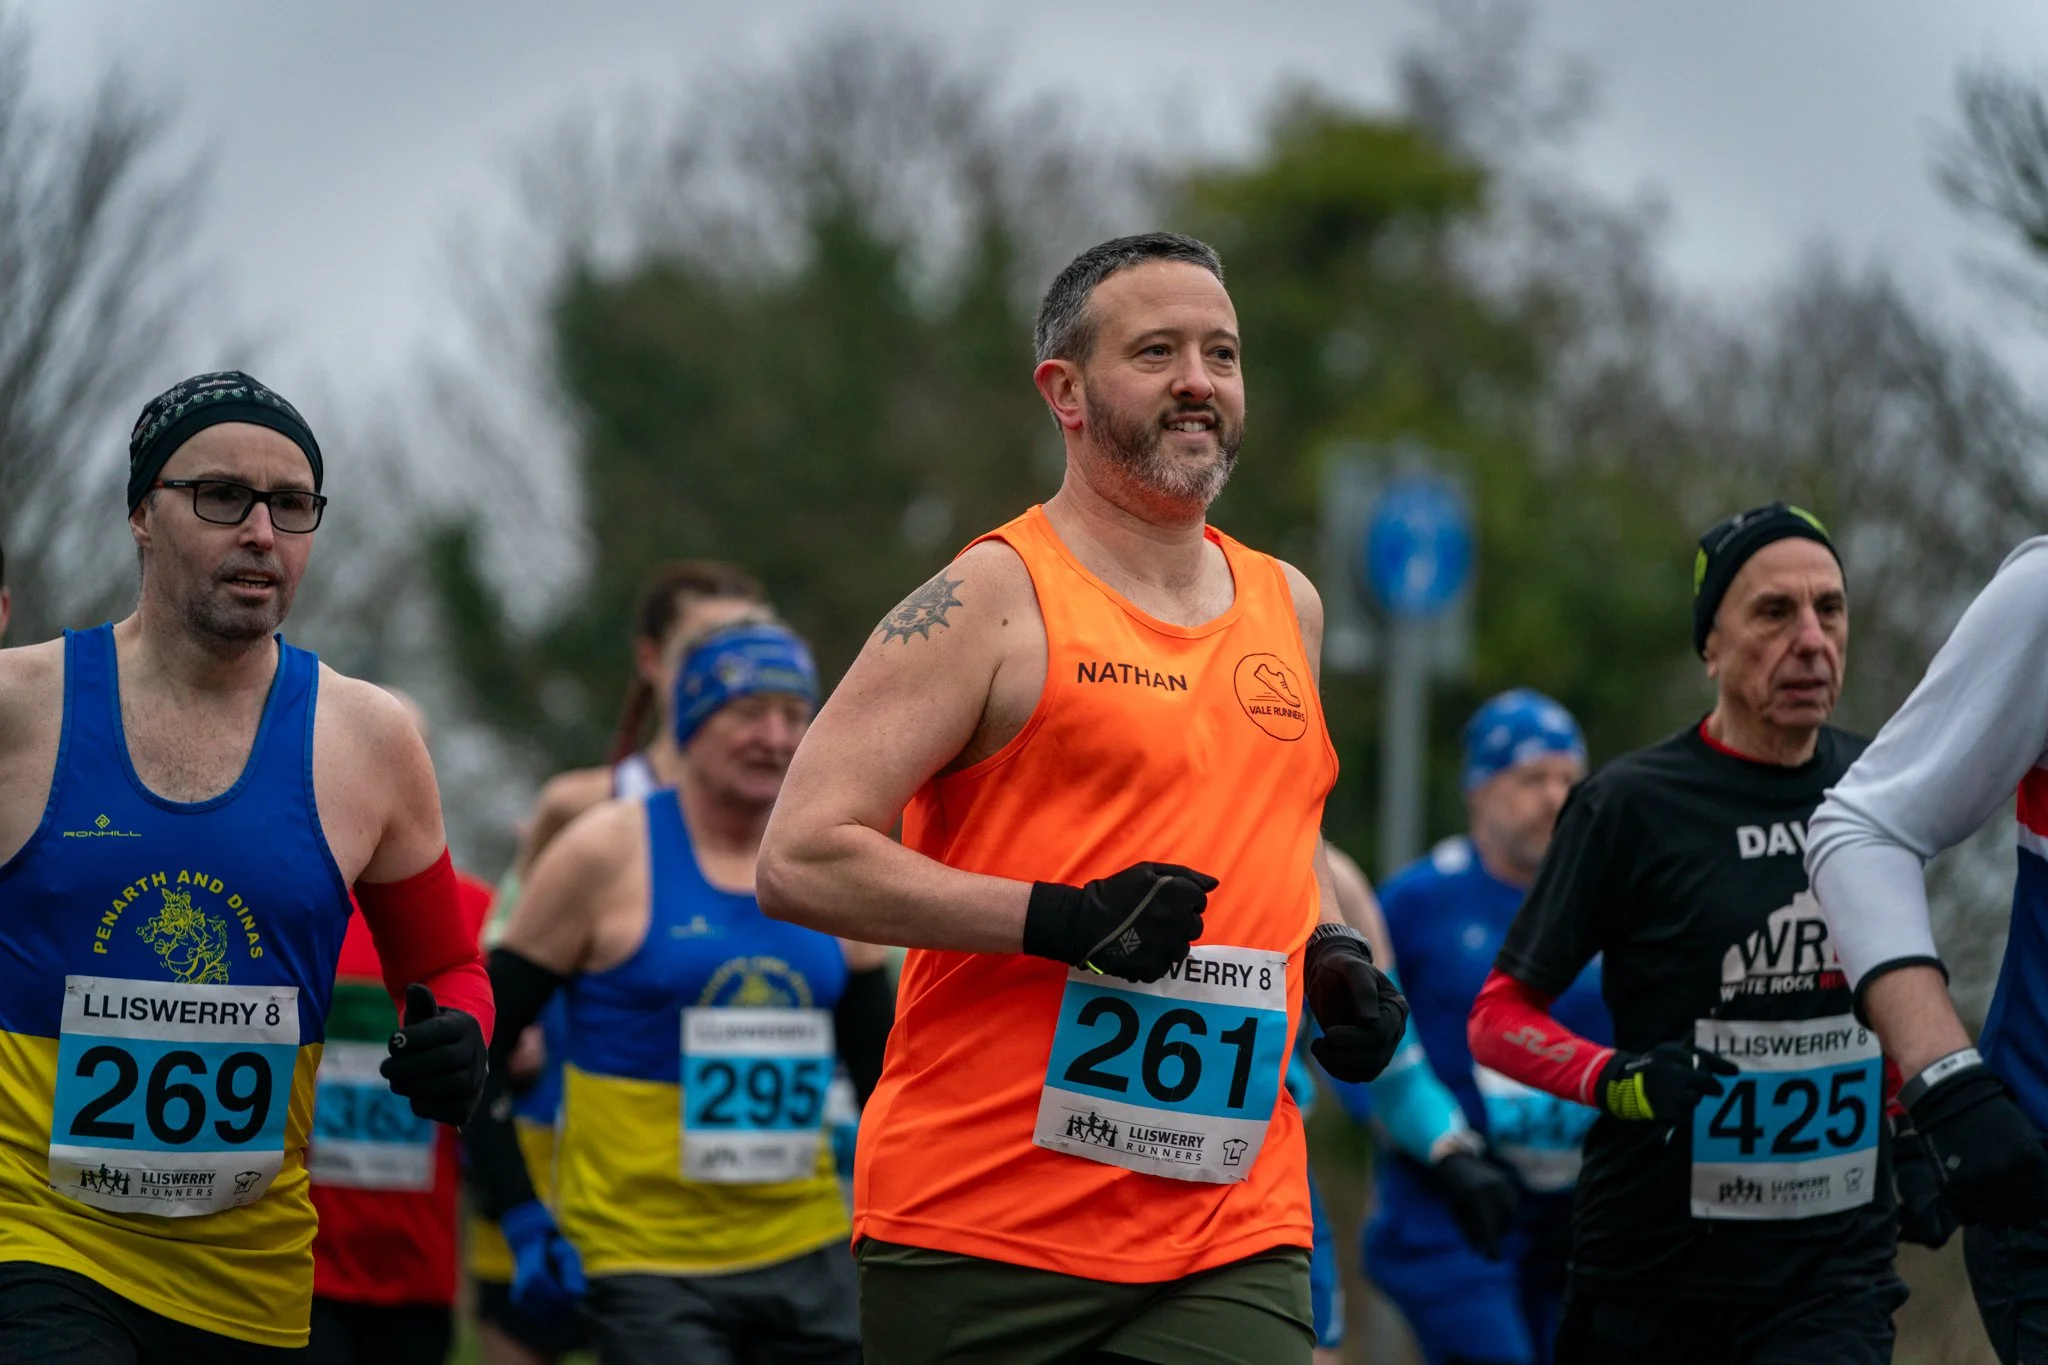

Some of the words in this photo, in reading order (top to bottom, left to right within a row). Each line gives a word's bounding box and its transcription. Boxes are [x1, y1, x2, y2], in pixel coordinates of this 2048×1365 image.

[1077, 661, 1188, 692] NATHAN
[1249, 705, 1272, 716] VALE
[1273, 706, 1306, 723] RUNNERS
[63, 830, 142, 838] RONHILL
[1736, 821, 1808, 860] DAV
[93, 871, 167, 955] PENARTH
[176, 869, 225, 895] AND
[226, 893, 264, 960] DINAS
[1258, 967, 1272, 990] 8
[1770, 975, 1815, 995] ROCK
[83, 994, 258, 1026] LLISWERRY
[264, 1003, 281, 1026] 8
[1063, 996, 1259, 1109] 261
[1713, 1027, 1853, 1057] LLISWERRY
[69, 1045, 273, 1145] 269
[696, 1062, 819, 1126] 295
[1708, 1069, 1867, 1156] 425
[1126, 1142, 1202, 1161] RUNNERS
[1129, 1126, 1205, 1149] LLISWERRY
[140, 1186, 213, 1197] RUNNERS
[141, 1172, 216, 1185] LLISWERRY
